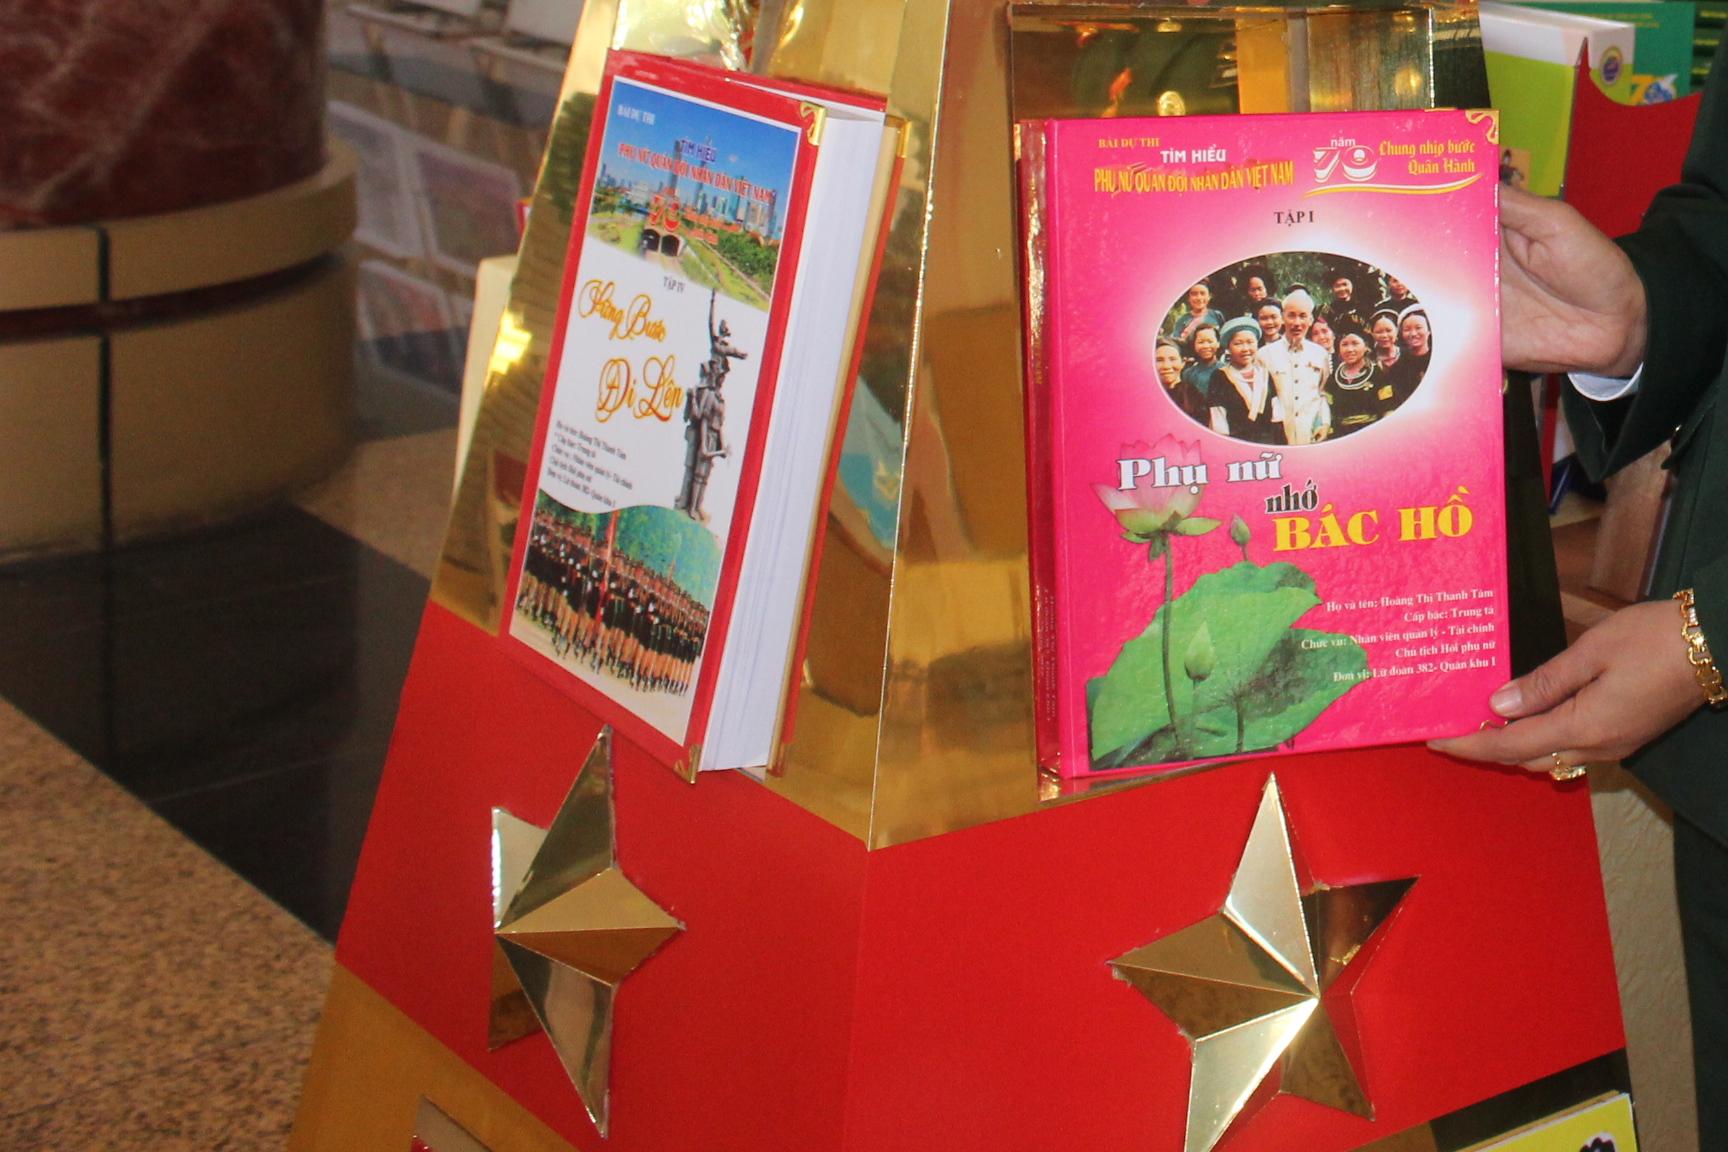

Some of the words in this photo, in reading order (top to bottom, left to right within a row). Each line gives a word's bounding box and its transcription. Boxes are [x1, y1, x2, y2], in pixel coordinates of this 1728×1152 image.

[680, 138, 695, 157] TÌM
[697, 136, 718, 163] HIỂU
[1099, 136, 1118, 148] BÀI
[1121, 137, 1136, 149] DỰ
[1141, 137, 1160, 147] THI
[1161, 147, 1186, 163] TÌM
[1192, 144, 1227, 163] HIỂU
[1331, 137, 1356, 147] năm
[1379, 140, 1416, 158] Chung
[1420, 140, 1443, 159] nhịp
[1448, 139, 1475, 154] bước
[1312, 145, 1378, 183] 70
[1408, 159, 1439, 175] Quân
[1443, 158, 1475, 174] Hành
[1094, 168, 1117, 198] PHỤ
[1168, 169, 1188, 196] ĐỘI
[1247, 160, 1268, 193] VIỆT
[1271, 160, 1294, 185] NAM
[1274, 210, 1305, 227] TẬP
[1309, 210, 1314, 223] I
[595, 358, 638, 423] Đi
[633, 355, 683, 422] Lên
[1117, 457, 1210, 495] Phụ
[1226, 452, 1283, 482] nữ
[1265, 479, 1318, 514] nhớ
[1273, 503, 1380, 552] BÁC
[1398, 485, 1473, 542] HỒ
[1327, 601, 1342, 613] Họ
[1345, 600, 1356, 610] và
[1359, 599, 1378, 609] tên:
[1381, 596, 1414, 608] Hoàng
[1416, 593, 1433, 604] Thị
[1436, 590, 1468, 602] Thanh
[1471, 588, 1494, 598] Tâm
[1404, 611, 1425, 623] Cấp
[1451, 606, 1482, 618] Trung
[1484, 606, 1494, 616] tá
[1301, 637, 1328, 649] Chức
[1350, 633, 1377, 645] Nhân
[1380, 631, 1400, 641] viên
[1402, 629, 1427, 642] quản
[1430, 626, 1439, 637] lý
[1449, 625, 1465, 636] Tài
[1467, 622, 1495, 633] chính
[1395, 646, 1417, 657] Chủ
[1420, 644, 1438, 655] tịch
[1461, 642, 1481, 654] phụ
[1483, 640, 1496, 650] nữ
[1333, 671, 1354, 682] Đơn
[1389, 663, 1414, 675] đoàn
[1440, 660, 1467, 672] Quân
[1469, 658, 1489, 669] khu
